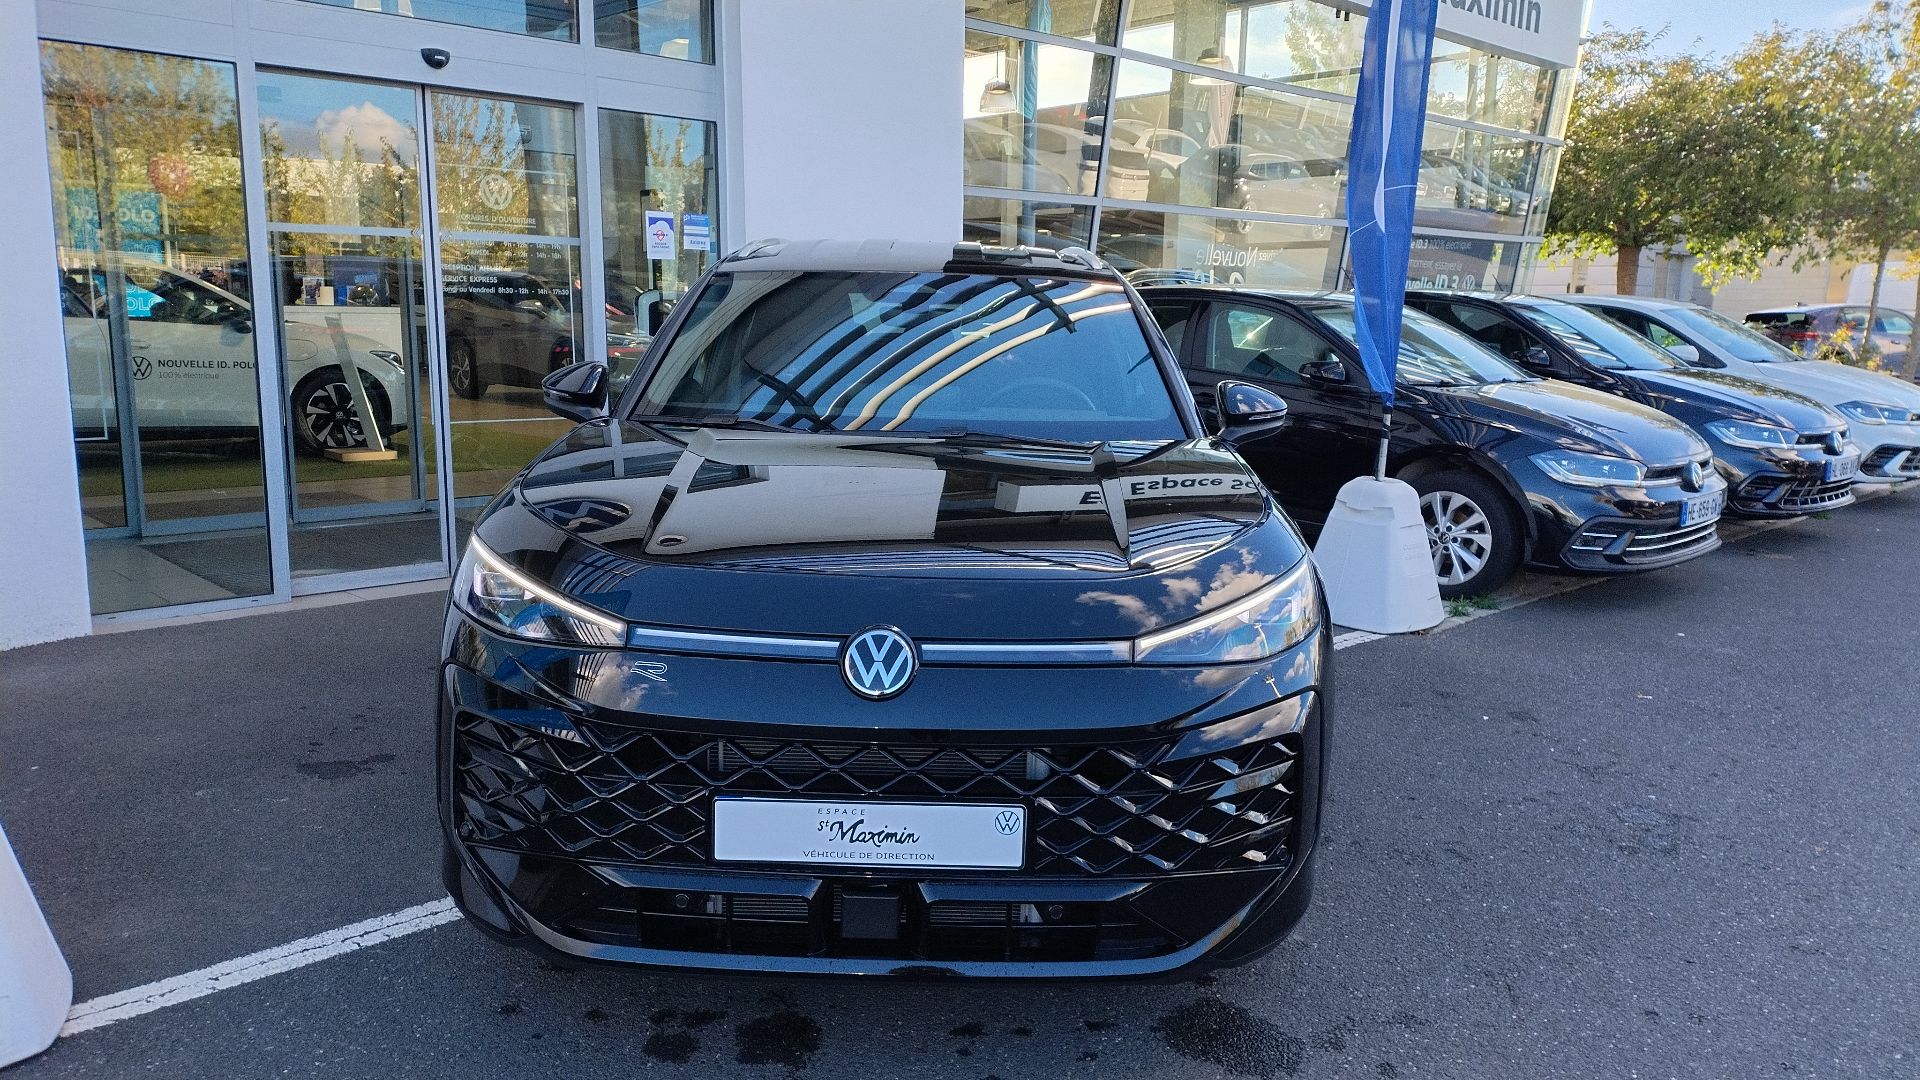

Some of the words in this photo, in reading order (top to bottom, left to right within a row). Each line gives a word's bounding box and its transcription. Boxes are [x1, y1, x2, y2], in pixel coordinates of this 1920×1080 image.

[1437, 0, 1541, 34] ximin
[467, 286, 496, 294] Vendredi
[519, 287, 529, 295] 12h
[157, 359, 215, 369] NOUVELLE
[217, 360, 231, 369] ID.
[817, 807, 867, 816] ESPACE
[817, 819, 830, 832] St
[828, 818, 921, 848] Maximin
[803, 849, 856, 859] VÉHICULE
[858, 852, 875, 860] DE
[875, 852, 936, 861] DIRECTION
